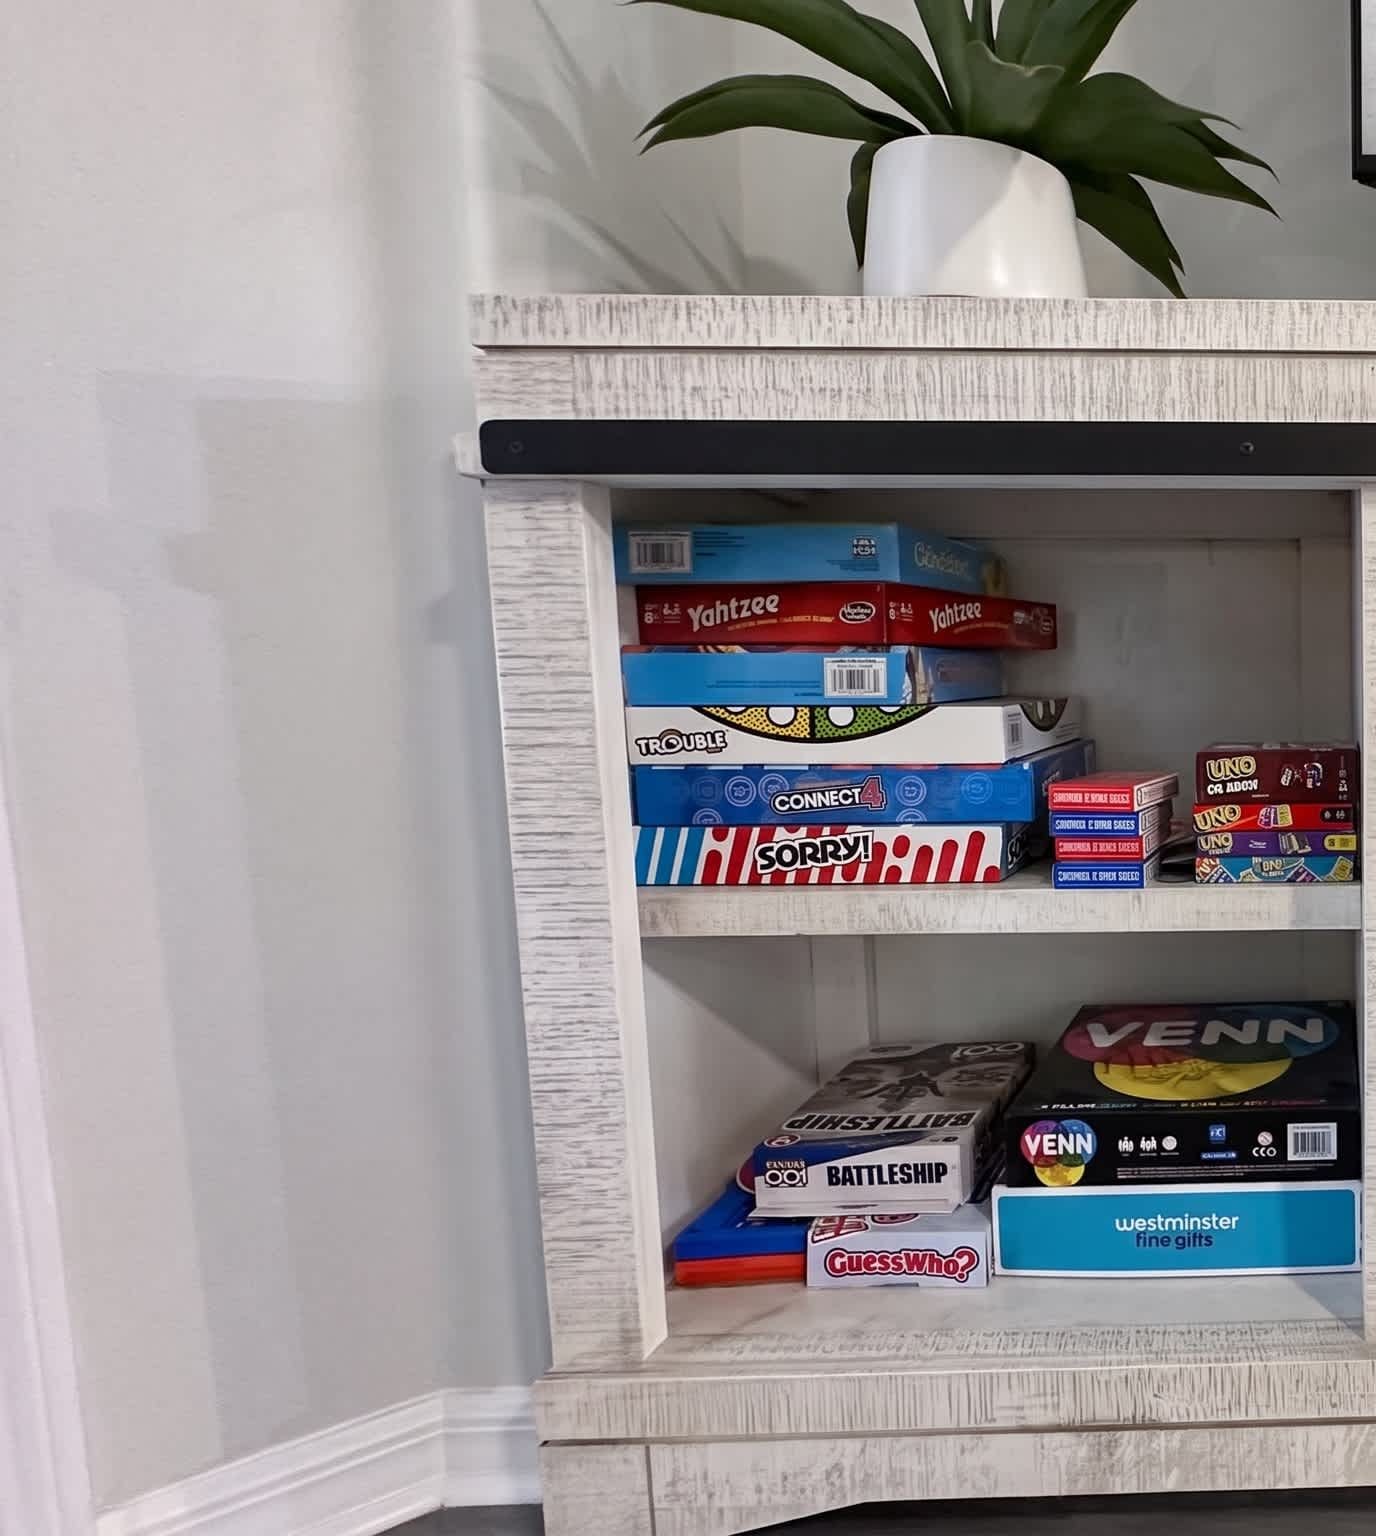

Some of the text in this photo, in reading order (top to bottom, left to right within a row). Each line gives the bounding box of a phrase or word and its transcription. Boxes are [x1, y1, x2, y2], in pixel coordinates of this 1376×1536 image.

[687, 594, 780, 632] Yahtzee
[929, 602, 982, 633] Yahtzee
[636, 730, 728, 755] TROUBLE
[1207, 756, 1257, 781] UNO
[1193, 804, 1241, 831] UNO
[757, 834, 870, 871] SORRY!
[1199, 832, 1232, 851] UNO
[1086, 1018, 1325, 1048] VENN
[785, 1112, 976, 1130] BATTLESHIP
[1025, 1133, 1092, 1156] VENN
[827, 1163, 949, 1186] BATTLESHIP
[1115, 1213, 1239, 1232] westminster
[1136, 1232, 1214, 1250] fine gifts
